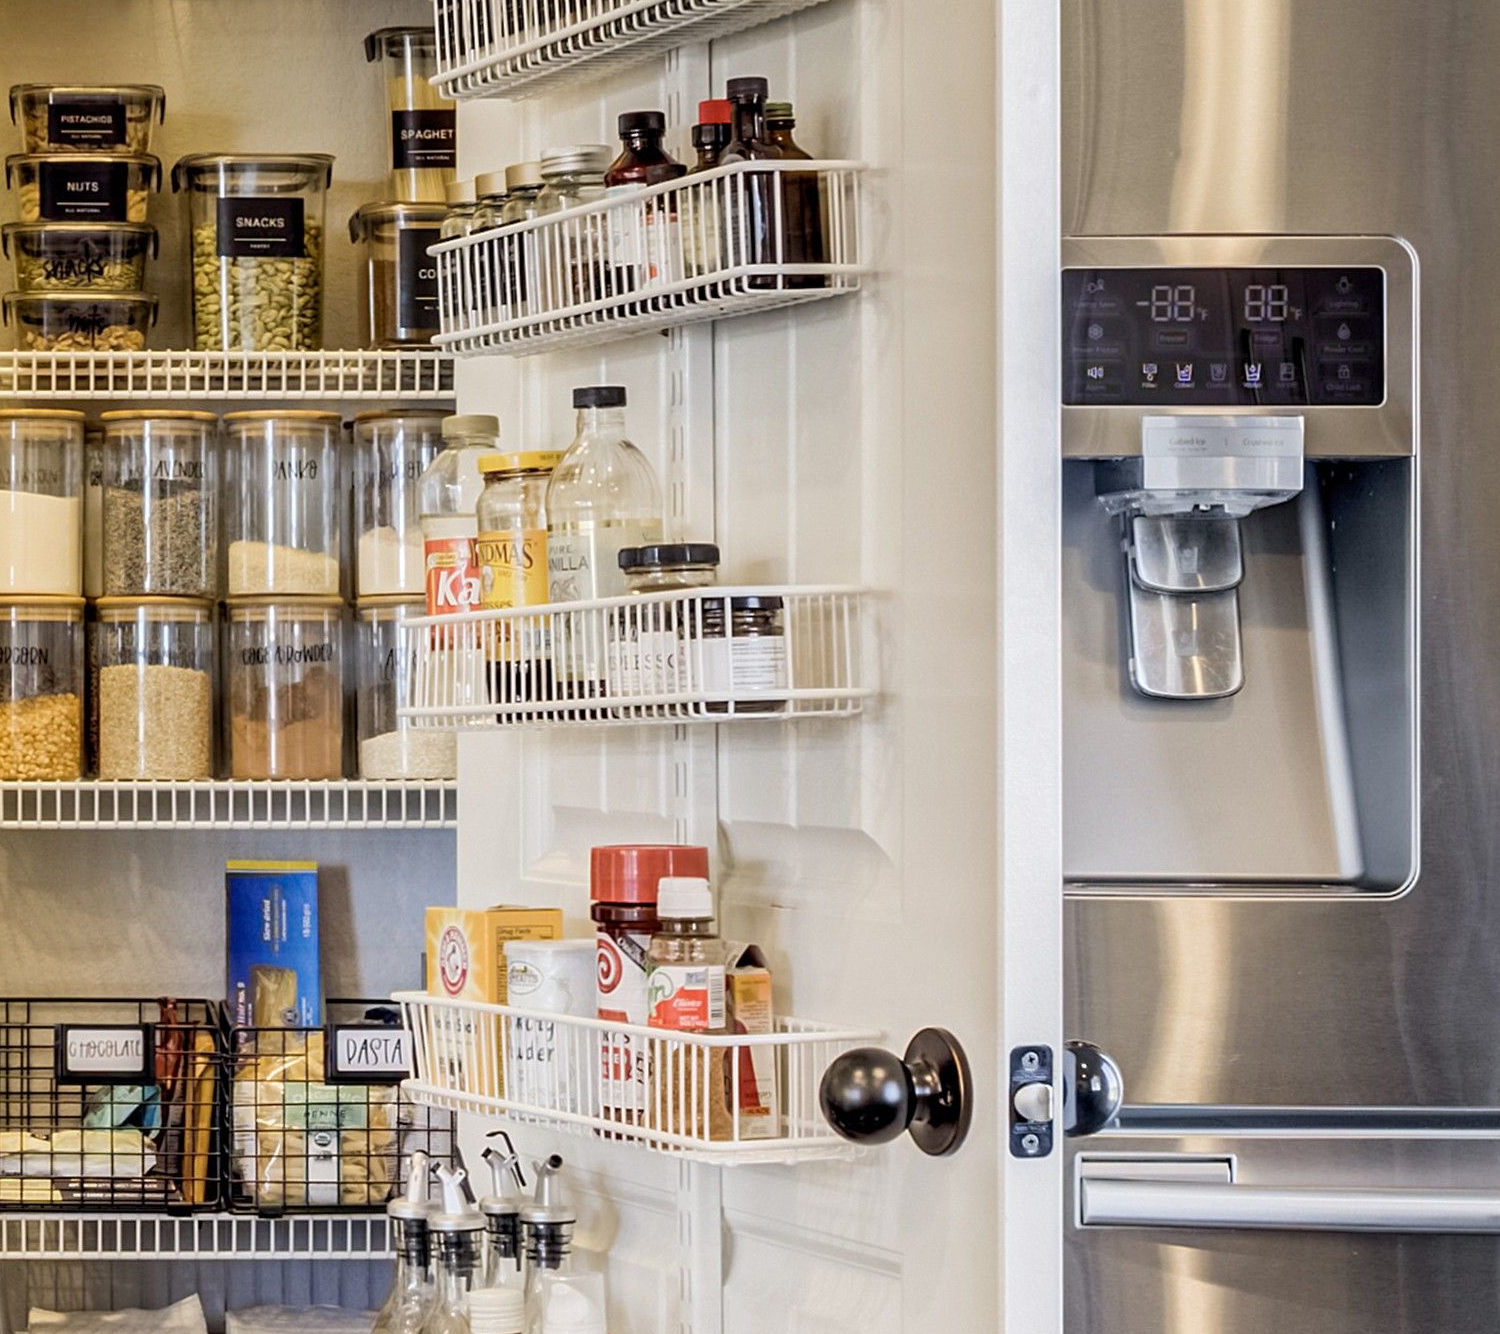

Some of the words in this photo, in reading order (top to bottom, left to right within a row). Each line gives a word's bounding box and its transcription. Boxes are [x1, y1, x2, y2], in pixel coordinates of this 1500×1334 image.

[61, 115, 113, 124] PISTACHIOS
[400, 128, 454, 140] SPAGHET
[67, 181, 99, 192] NUTS
[236, 217, 285, 228] SNACKS
[550, 555, 589, 572] NILLA
[437, 570, 481, 606] Ka
[69, 1041, 142, 1058] CHOCOLATE
[346, 1038, 403, 1066] PASTA
